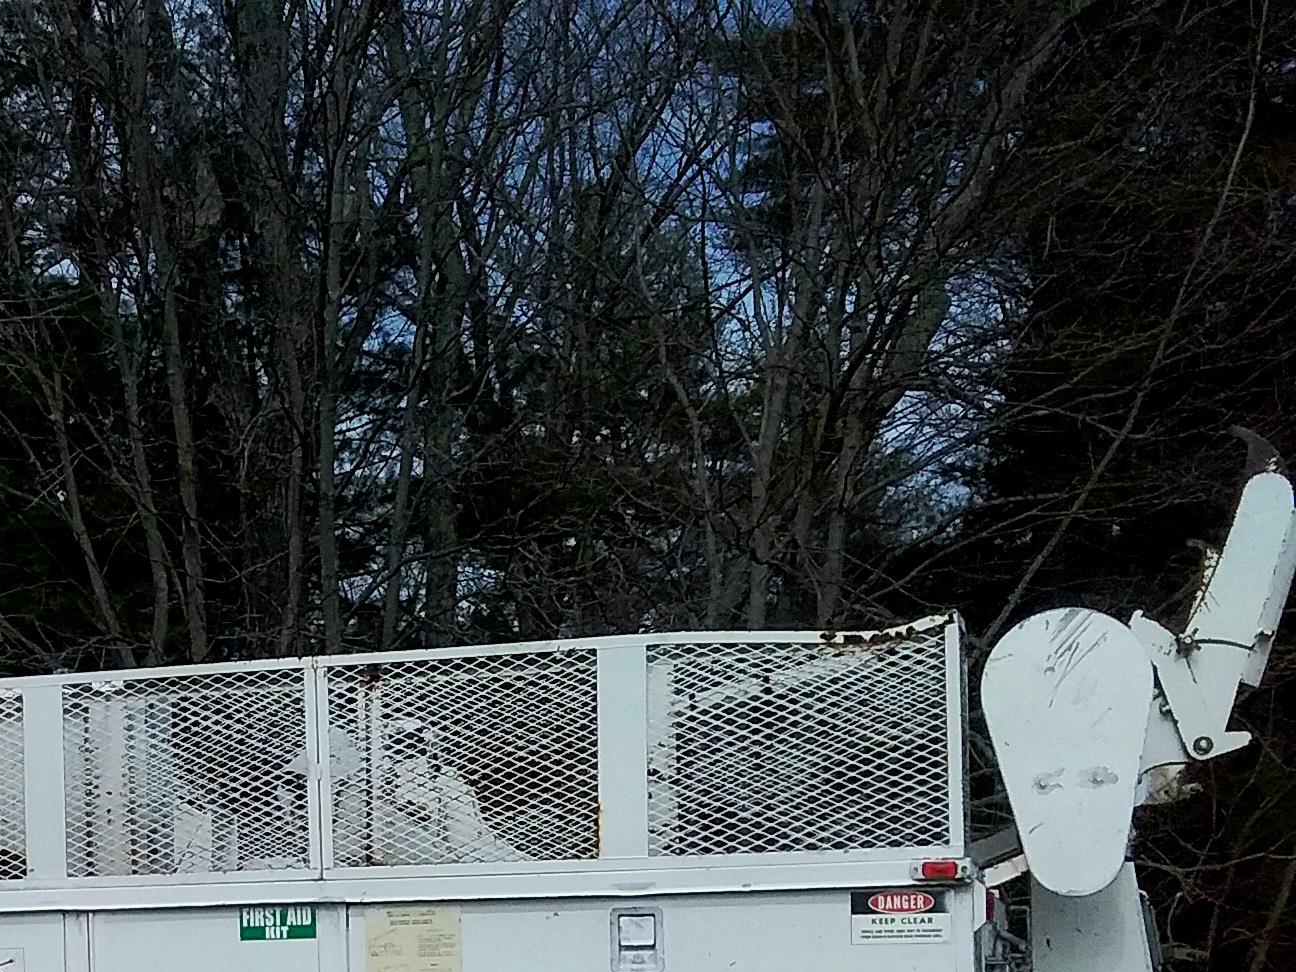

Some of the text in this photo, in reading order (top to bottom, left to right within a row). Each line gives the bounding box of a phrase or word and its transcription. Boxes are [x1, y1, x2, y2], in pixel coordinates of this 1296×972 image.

[877, 895, 925, 910] DANGER
[242, 905, 312, 928] FIRST AID
[871, 917, 933, 925] KEEP CLEAR
[265, 926, 289, 939] KIT
